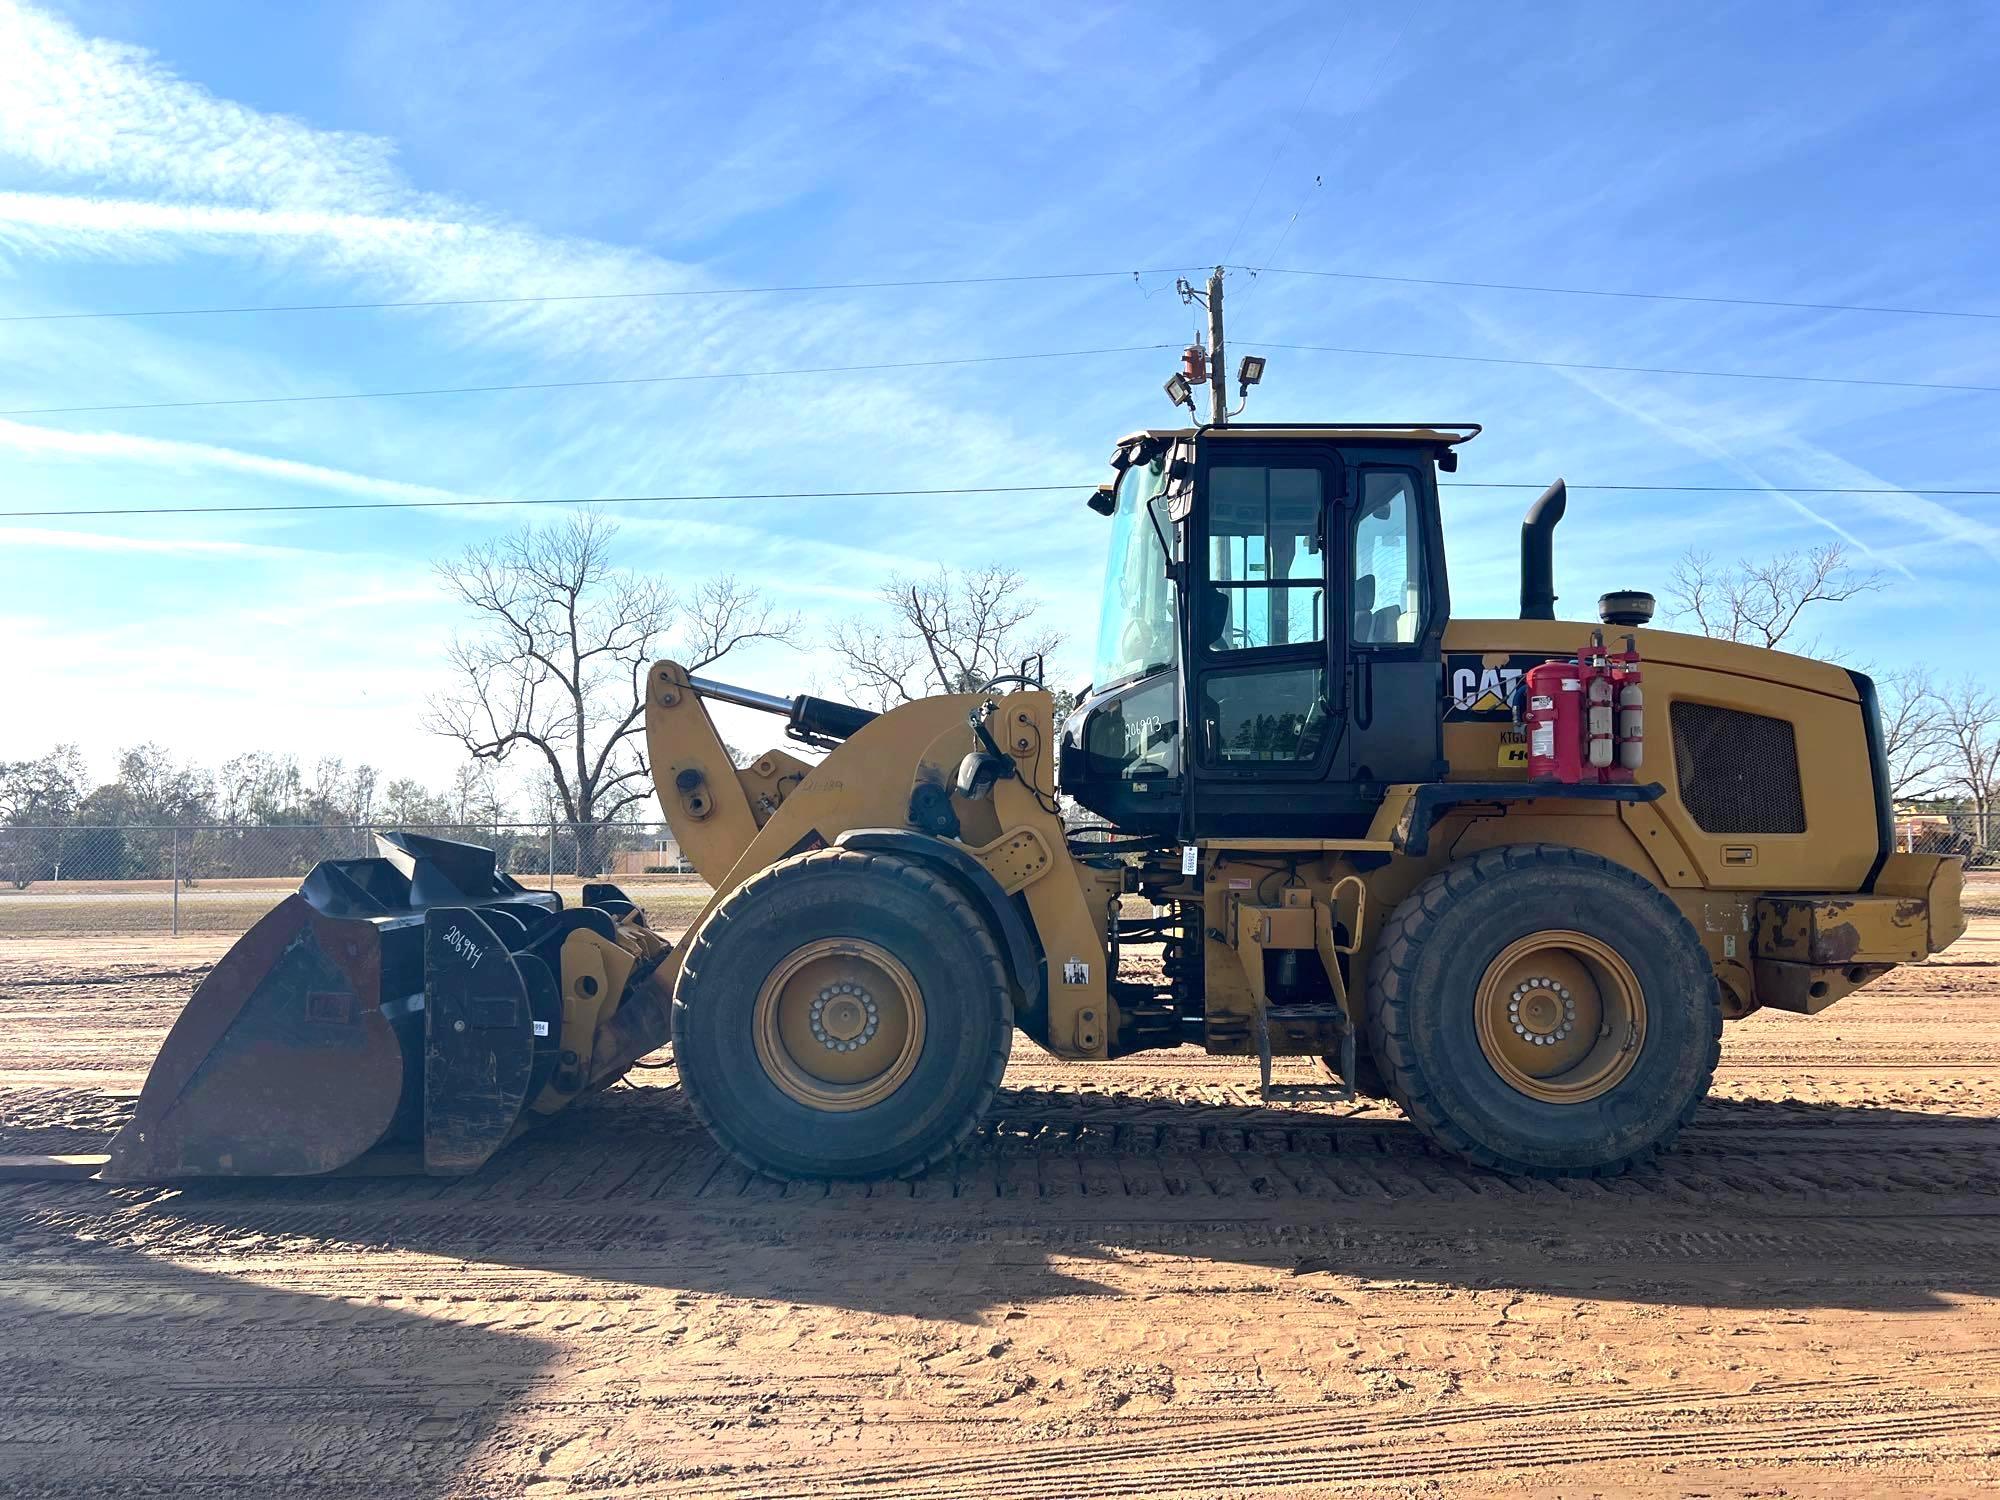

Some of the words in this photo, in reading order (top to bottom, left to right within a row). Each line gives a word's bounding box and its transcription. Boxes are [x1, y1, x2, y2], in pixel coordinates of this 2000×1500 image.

[1453, 668, 1522, 711] CAT
[1125, 715, 1162, 741] 206993
[442, 925, 483, 969] 206994
